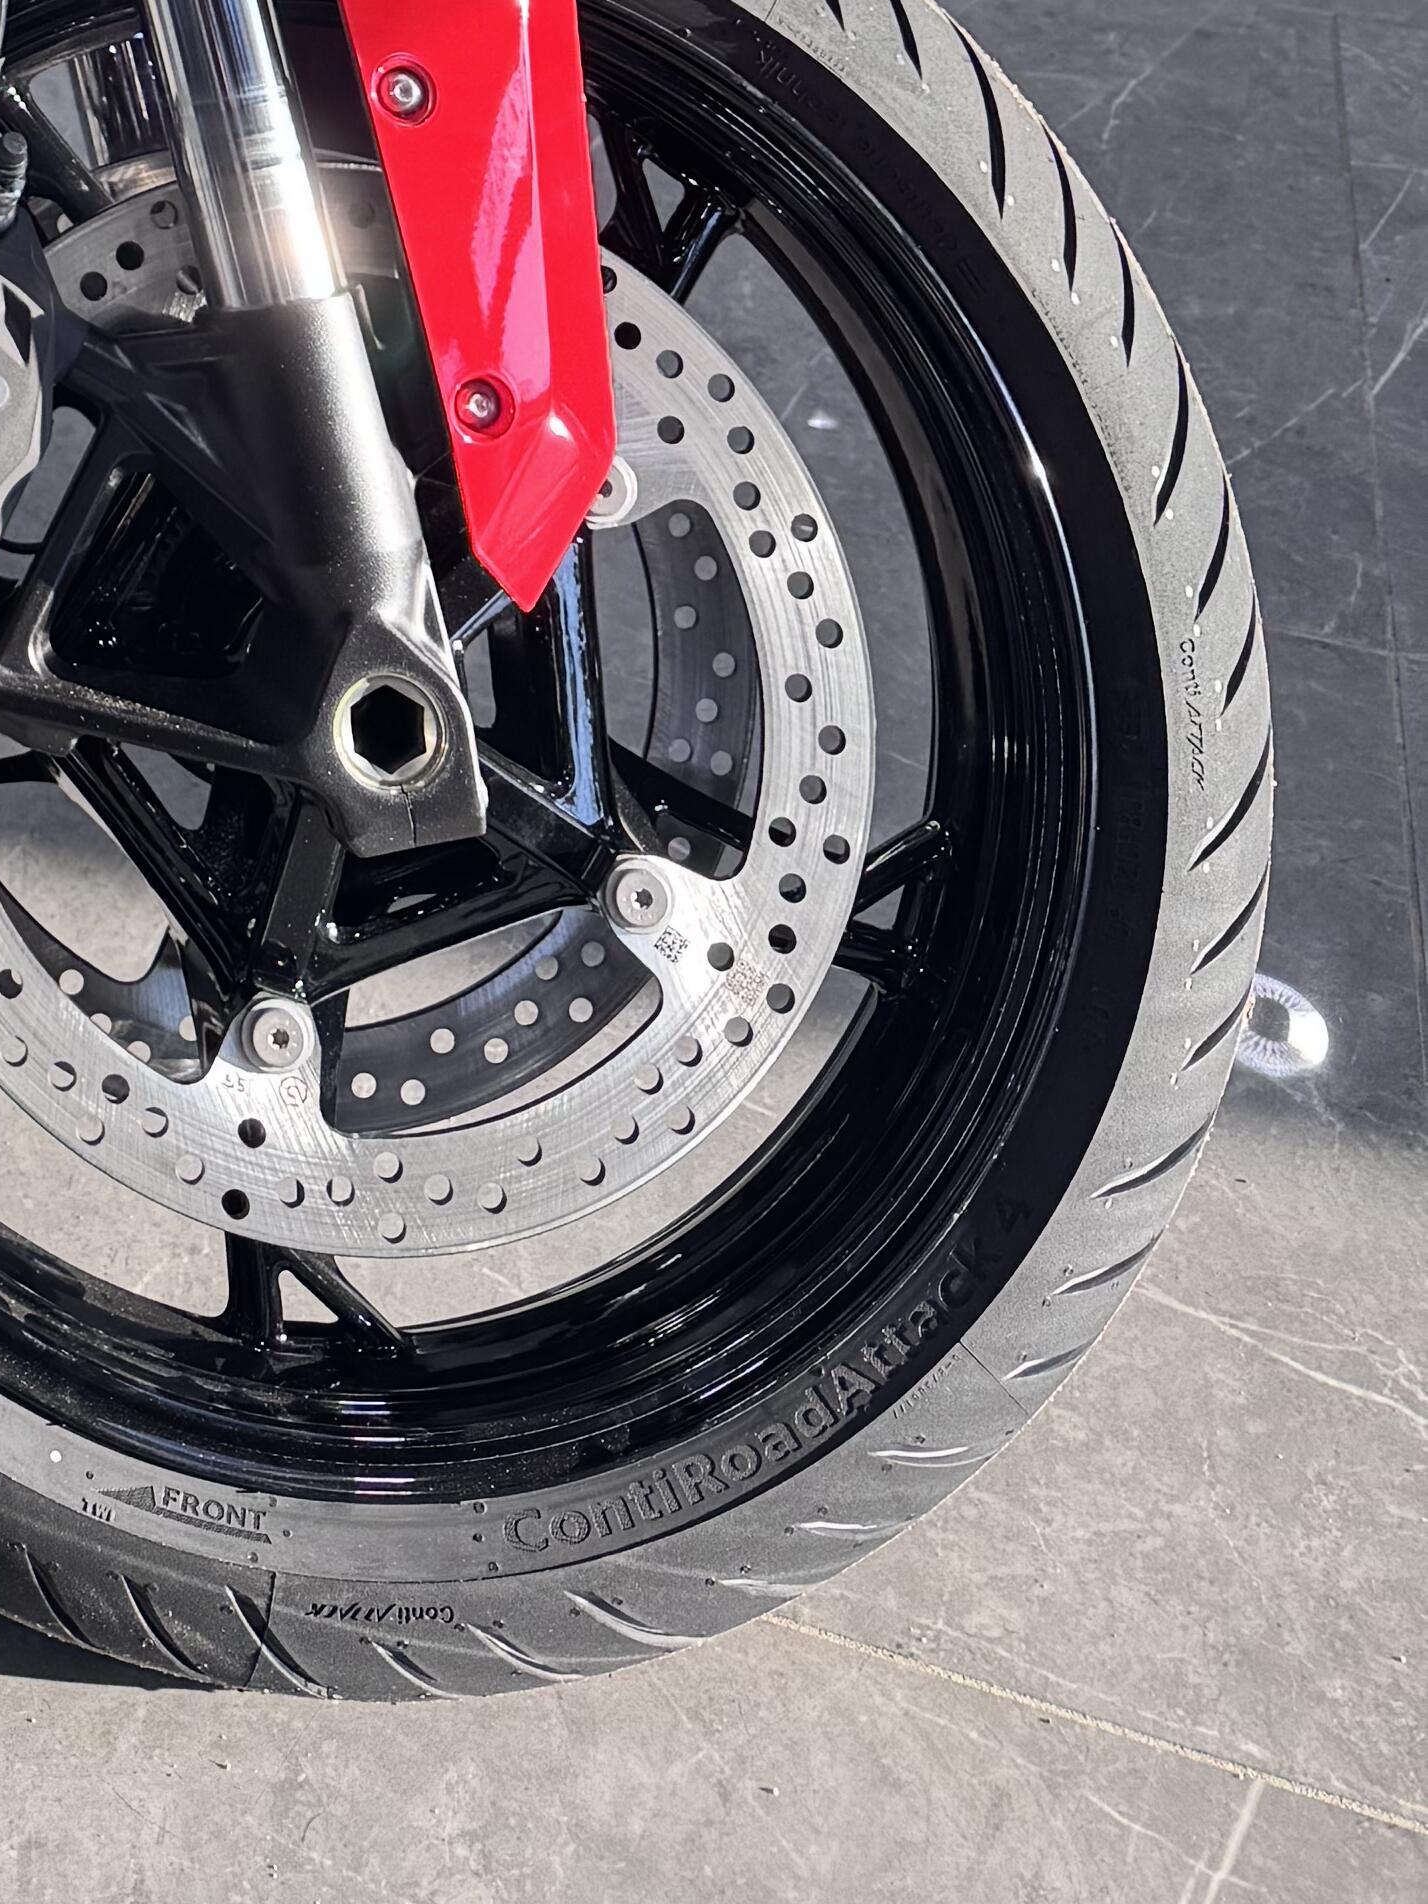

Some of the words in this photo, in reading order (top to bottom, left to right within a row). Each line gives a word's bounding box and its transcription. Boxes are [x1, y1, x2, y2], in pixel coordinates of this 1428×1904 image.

[501, 1235, 1005, 1556] ContiRoadAttack
[995, 1191, 1032, 1230] 4
[161, 1484, 269, 1531] FRONT
